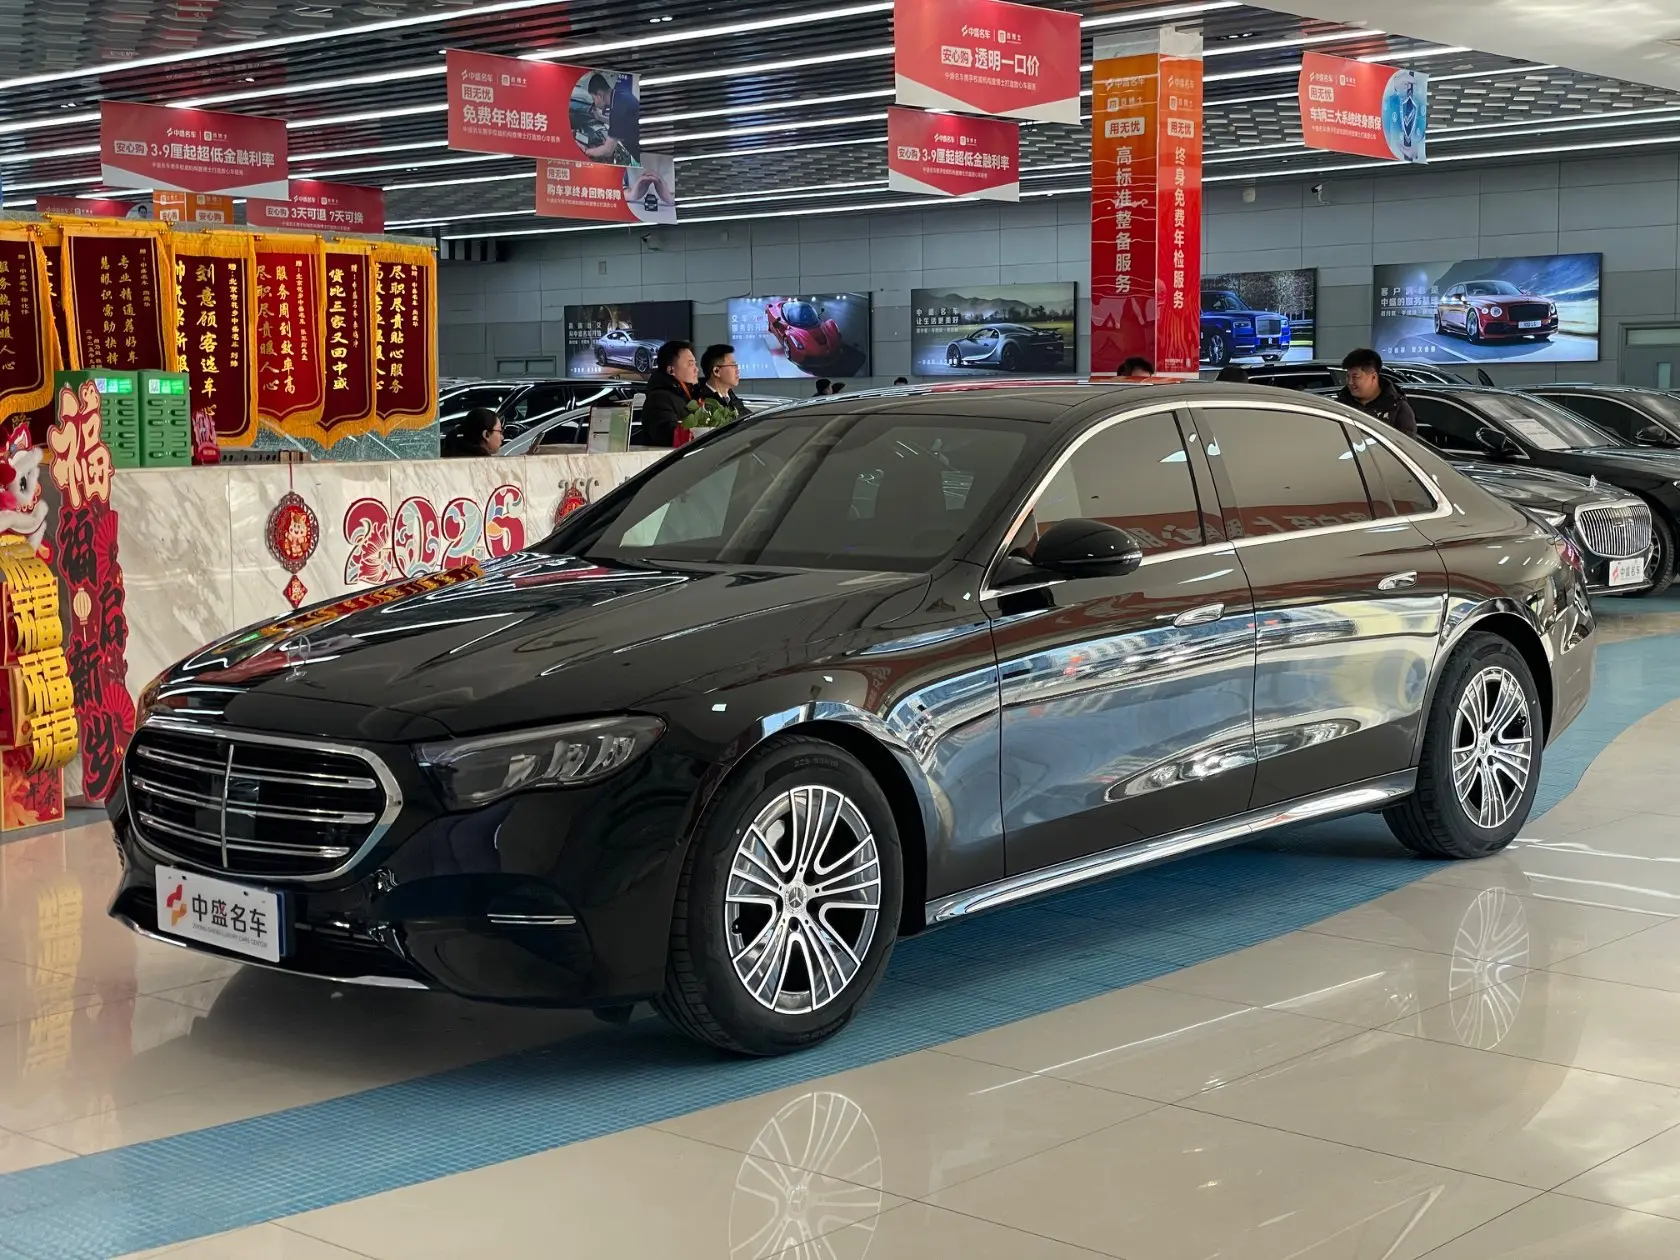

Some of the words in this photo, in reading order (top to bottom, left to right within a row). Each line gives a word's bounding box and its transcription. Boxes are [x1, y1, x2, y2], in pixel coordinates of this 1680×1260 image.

[968, 28, 991, 40] 中盛名车
[943, 48, 970, 65] 安心购
[975, 47, 1040, 77] 透明一口价
[468, 72, 494, 83] 中盛名车
[463, 87, 492, 101] 用无忧
[1311, 87, 1332, 100] 用无忧
[463, 106, 549, 132] 免费年检服务
[1109, 120, 1141, 134] 用无忧
[1170, 120, 1192, 135] 用无忧
[1310, 107, 1382, 130] 车辆三大系统终身质保
[173, 129, 197, 139] 中盛名车
[116, 142, 146, 154] 安心购
[151, 143, 275, 168] 3.9厘起超低金融利率
[899, 148, 919, 160] 安心购
[922, 149, 1010, 171] 3.9厘起超低金融利率
[547, 184, 621, 200] 购车享终身回购保障
[199, 211, 222, 223] 安心购
[267, 207, 288, 217] 安心购
[291, 207, 327, 221] 3天可退
[329, 210, 364, 225] 7天可换
[1115, 146, 1132, 294] 高标准整备服务
[1173, 146, 1186, 310] 终身免费年检服务
[256, 265, 281, 391] 尽职尽责暖人心
[275, 265, 296, 394] 服务周到效率高
[389, 265, 406, 393] 尽职尽责贴心服务
[52, 386, 111, 506] 福
[342, 484, 525, 586] 2026
[192, 894, 267, 938] 中盛名车
